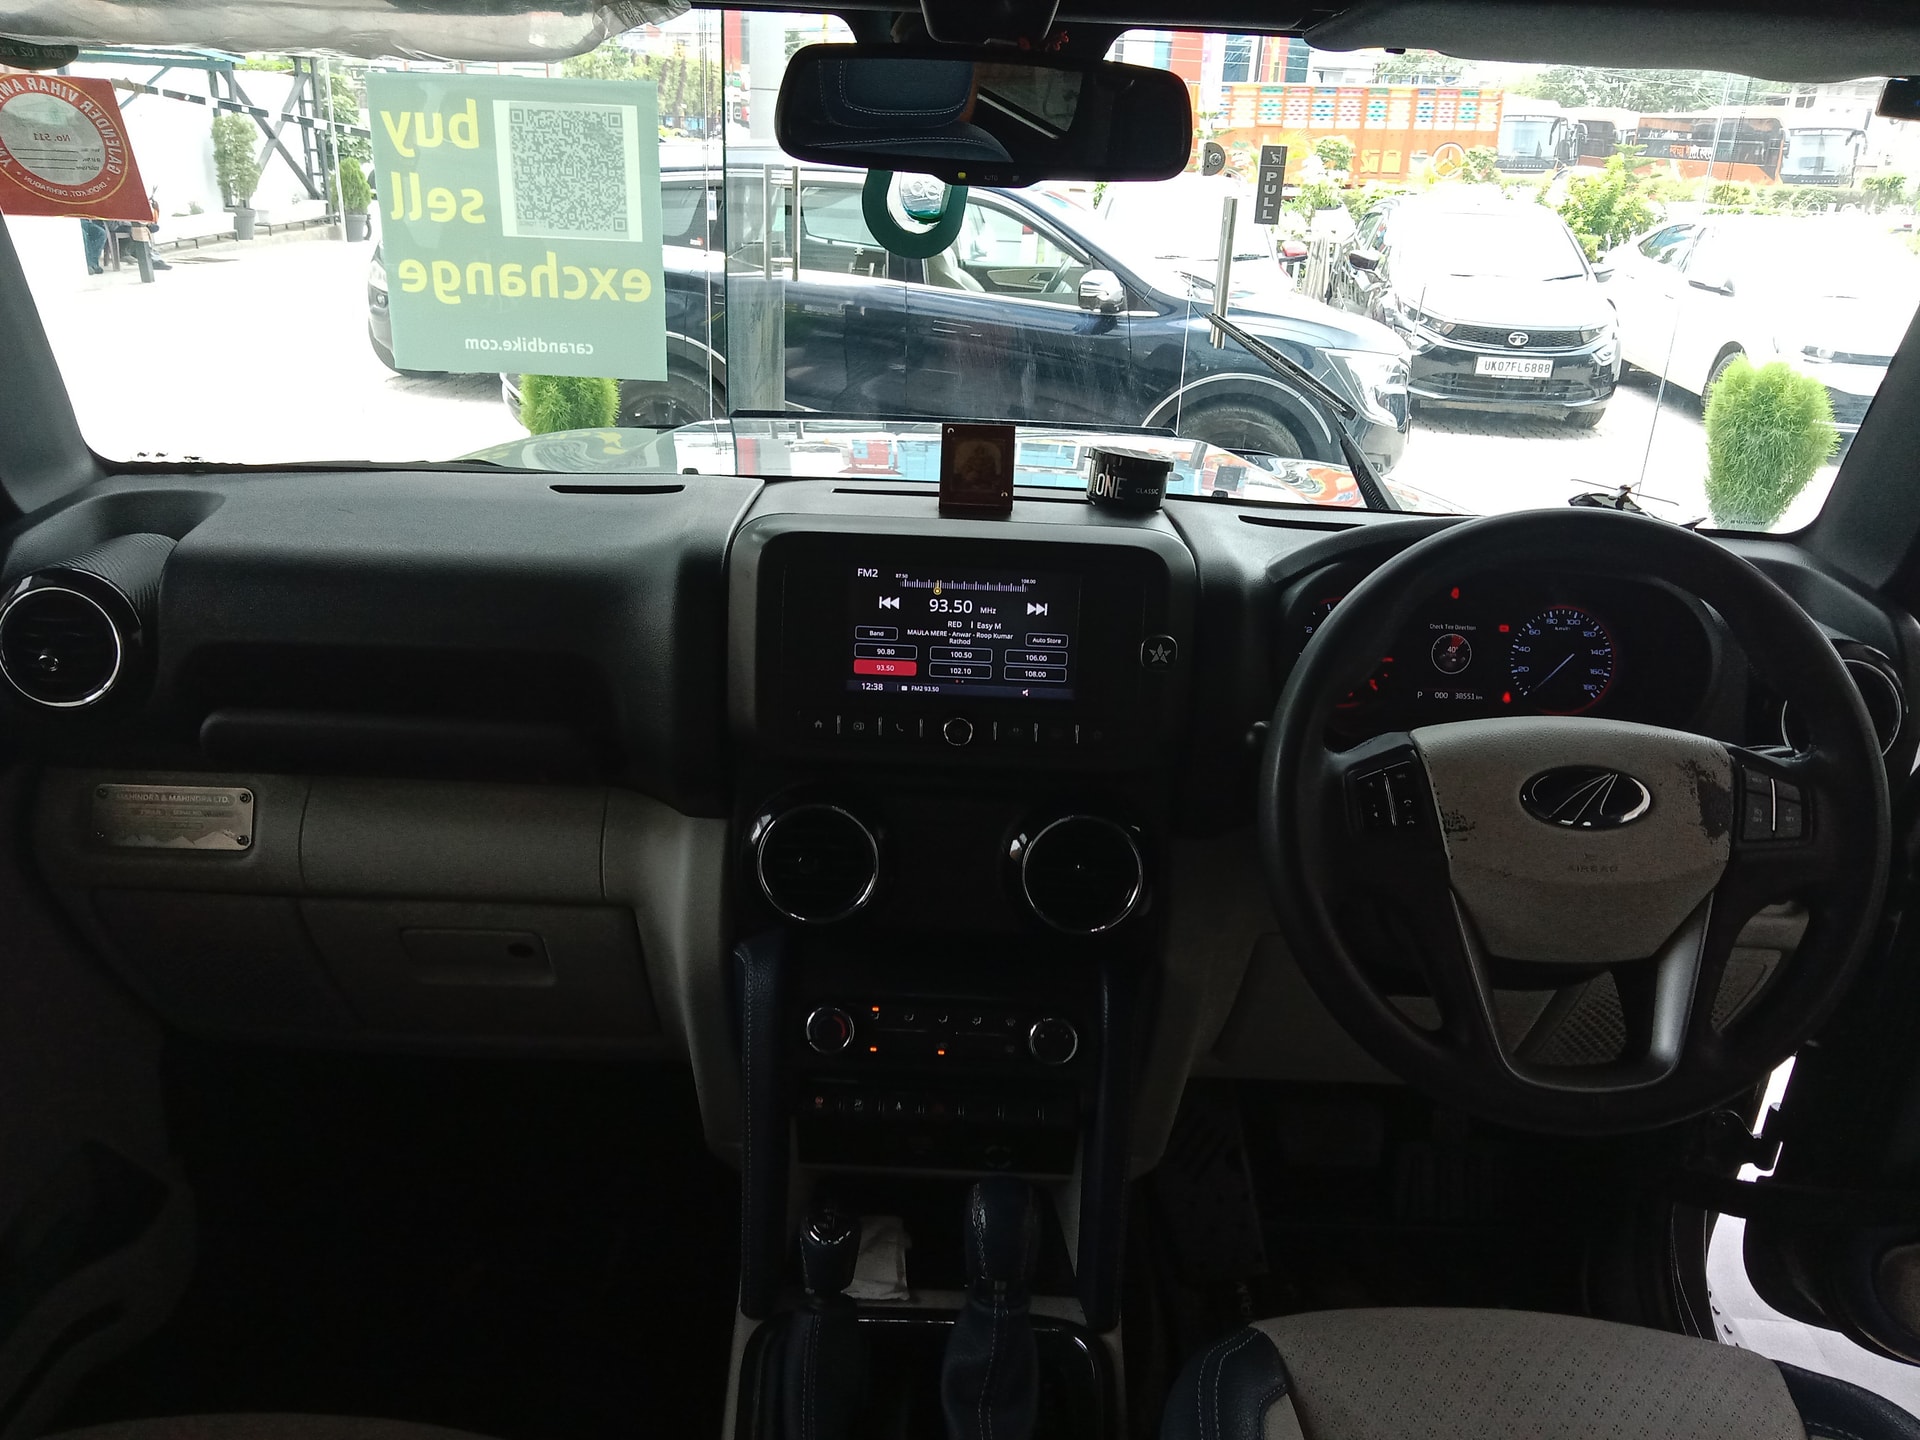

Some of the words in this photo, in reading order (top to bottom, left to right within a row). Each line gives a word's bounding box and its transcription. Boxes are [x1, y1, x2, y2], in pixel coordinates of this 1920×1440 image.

[1262, 172, 1278, 219] PULL
[1484, 360, 1551, 374] UK07FL6888
[1096, 472, 1127, 500] ONE
[857, 568, 878, 578] FM2
[929, 598, 973, 613] 93.50
[980, 607, 997, 615] MHz
[977, 622, 993, 631] Easy
[994, 622, 1002, 630] M
[869, 629, 884, 637] Band
[976, 632, 992, 640] Roop
[993, 632, 1013, 640] Kumar
[950, 651, 972, 659] 100.50
[1025, 654, 1048, 662] 106.00
[876, 664, 895, 672] 93.50
[950, 667, 972, 675] 102.10
[1024, 670, 1047, 678] 108.00
[861, 682, 884, 691] 12:38
[1417, 690, 1423, 699] P
[117, 791, 160, 802] MAHINDRA
[168, 793, 212, 803] MAHINDRA
